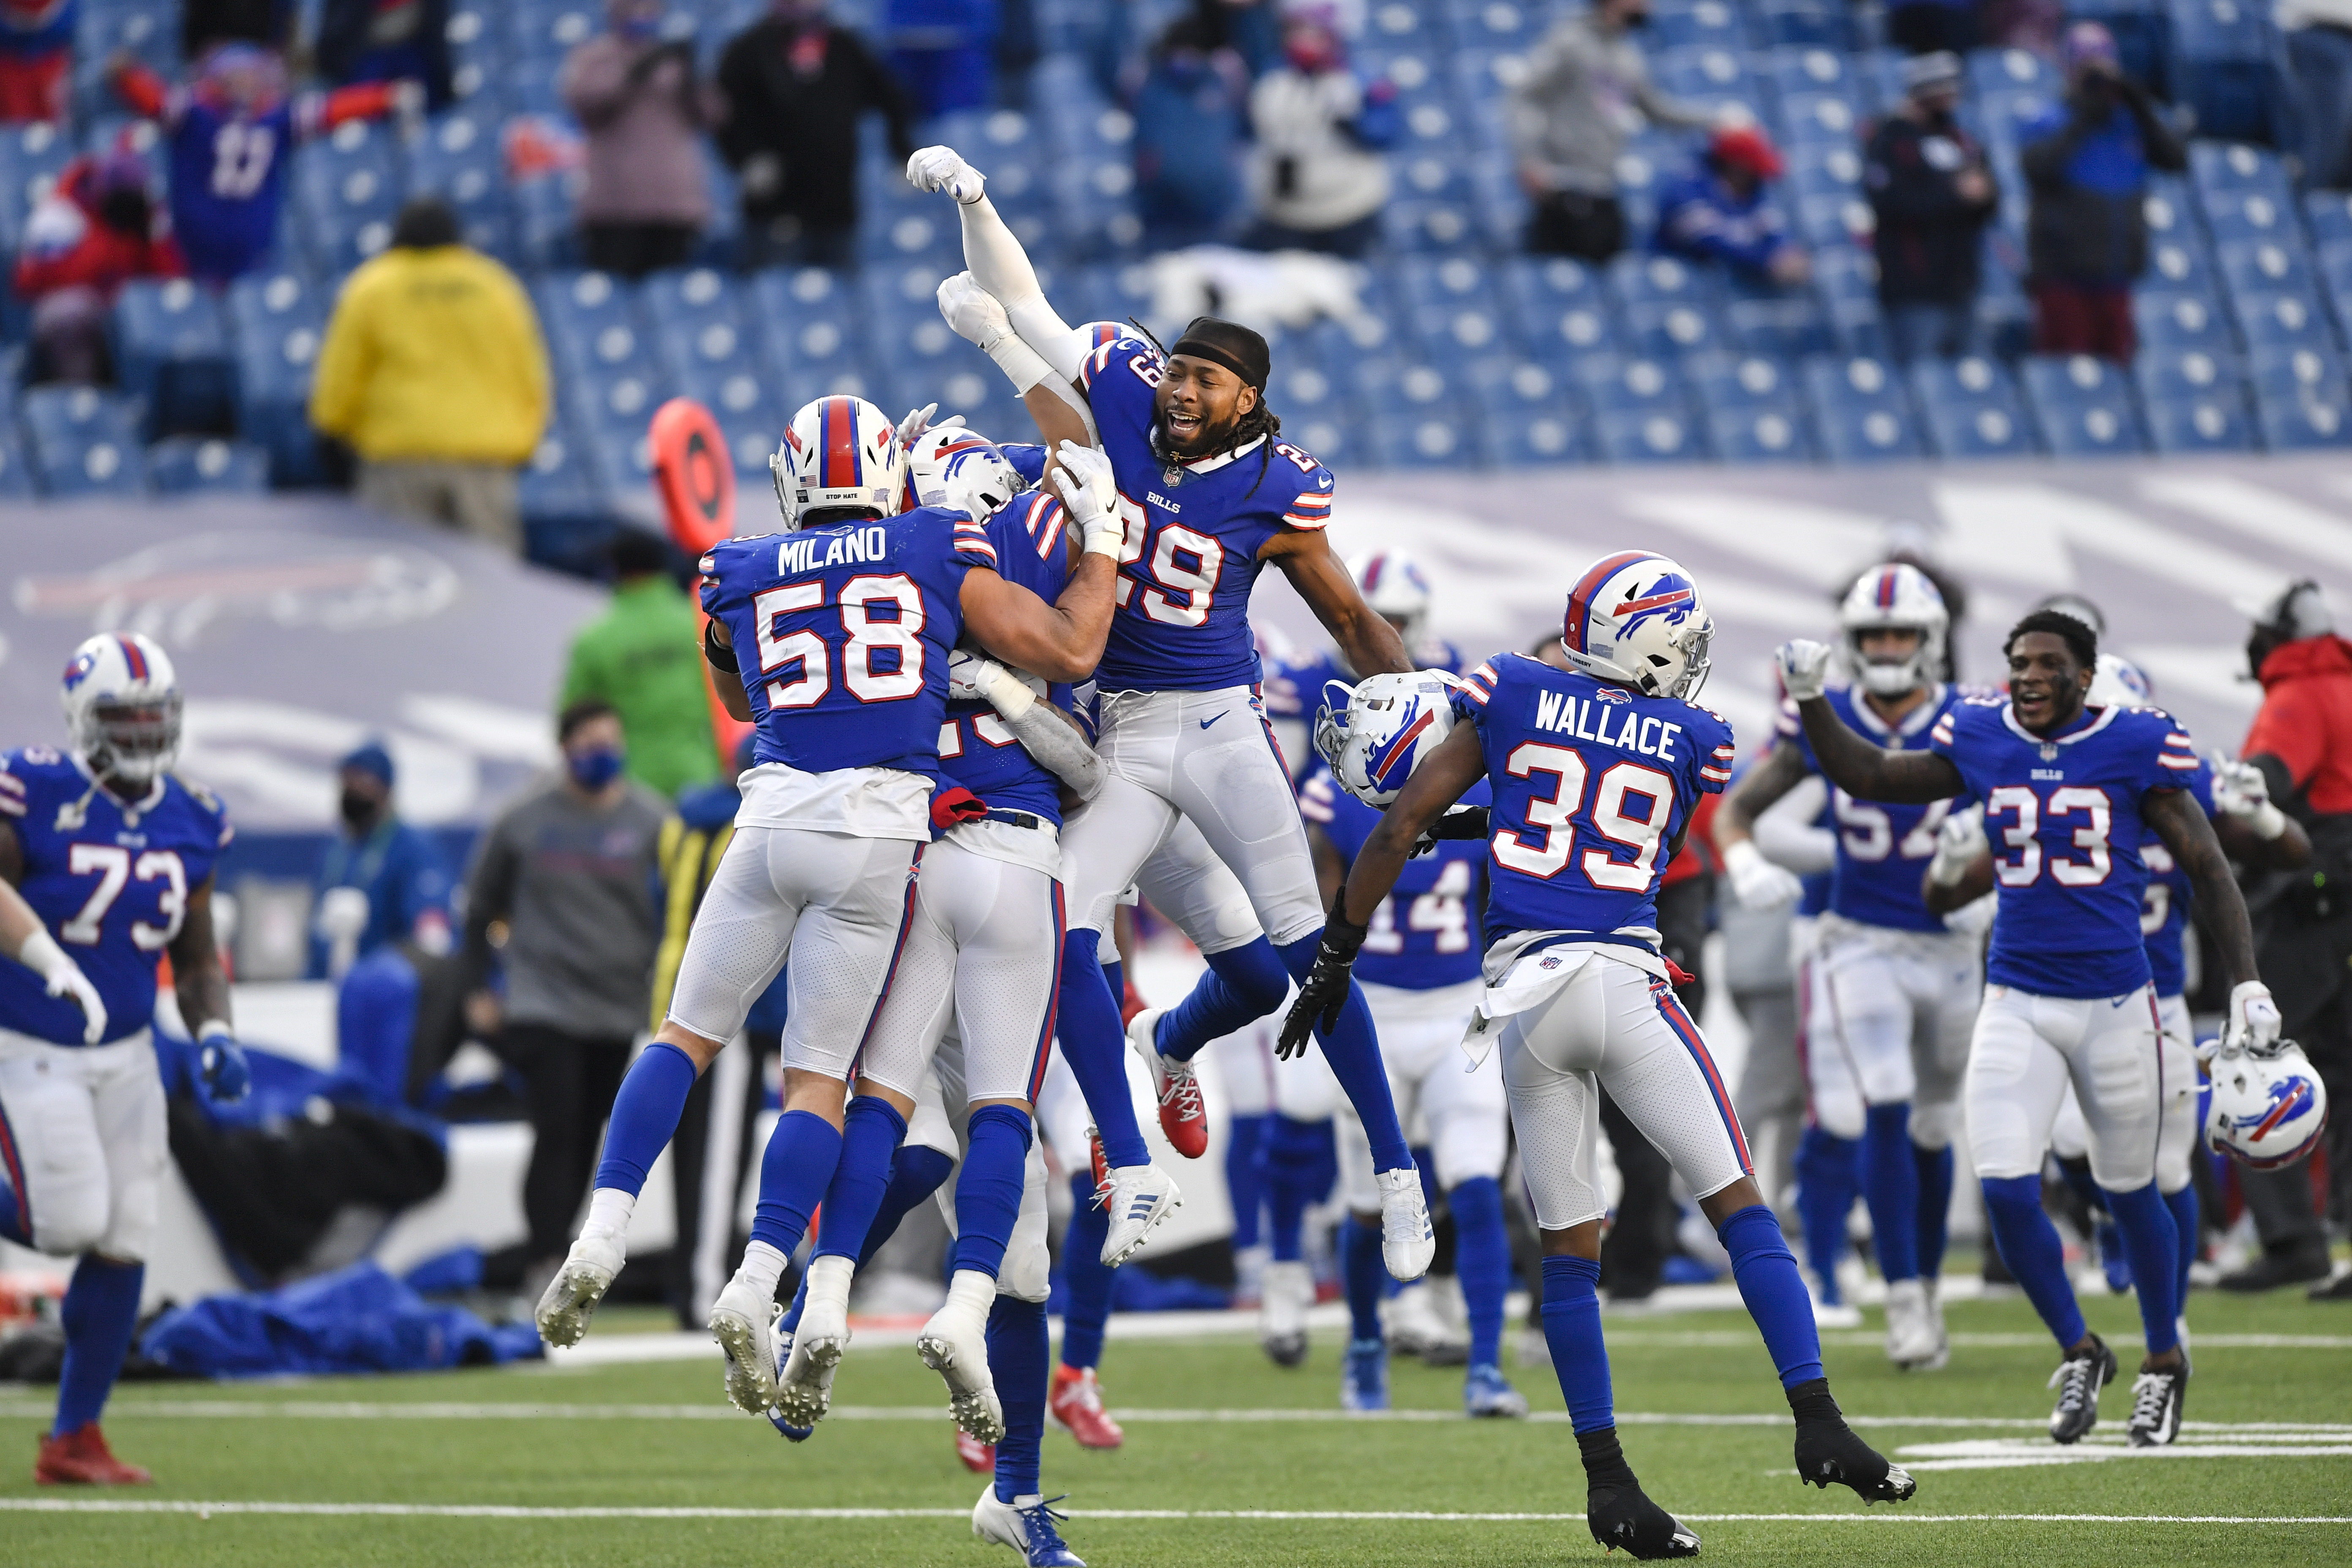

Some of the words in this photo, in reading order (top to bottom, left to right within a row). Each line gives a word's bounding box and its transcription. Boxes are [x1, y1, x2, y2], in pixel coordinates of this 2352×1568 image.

[1146, 491, 1181, 513] BILLS
[1167, 474, 1177, 484] NFL
[1274, 442, 1324, 474] 2
[778, 526, 886, 576] MILANO
[1116, 490, 1225, 628] 29
[751, 572, 926, 710] 58
[1535, 689, 1682, 762] WALLACE
[1491, 740, 1675, 895] 39
[1988, 786, 2112, 887] 33
[60, 842, 187, 951] 73
[1361, 860, 1470, 955] 14
